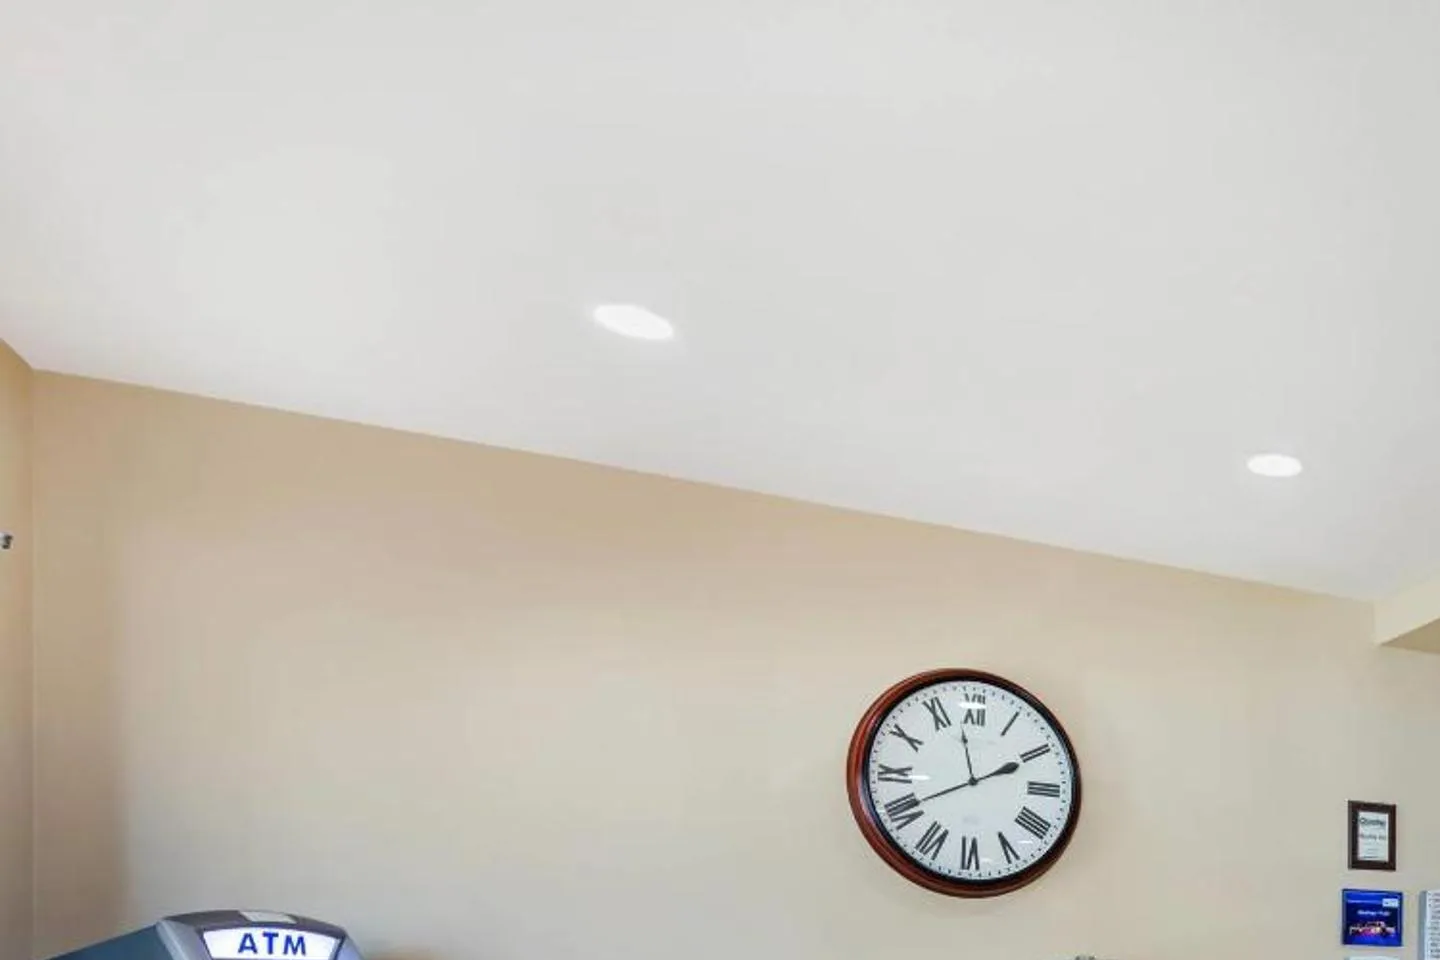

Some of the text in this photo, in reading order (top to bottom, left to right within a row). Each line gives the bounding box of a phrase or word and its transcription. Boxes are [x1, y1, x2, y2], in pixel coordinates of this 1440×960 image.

[923, 696, 951, 731] XI
[889, 724, 924, 752] X
[878, 764, 912, 783] IX
[1027, 781, 1061, 798] III
[961, 836, 980, 871] VI
[998, 831, 1021, 864] V
[238, 930, 307, 956] ATM
